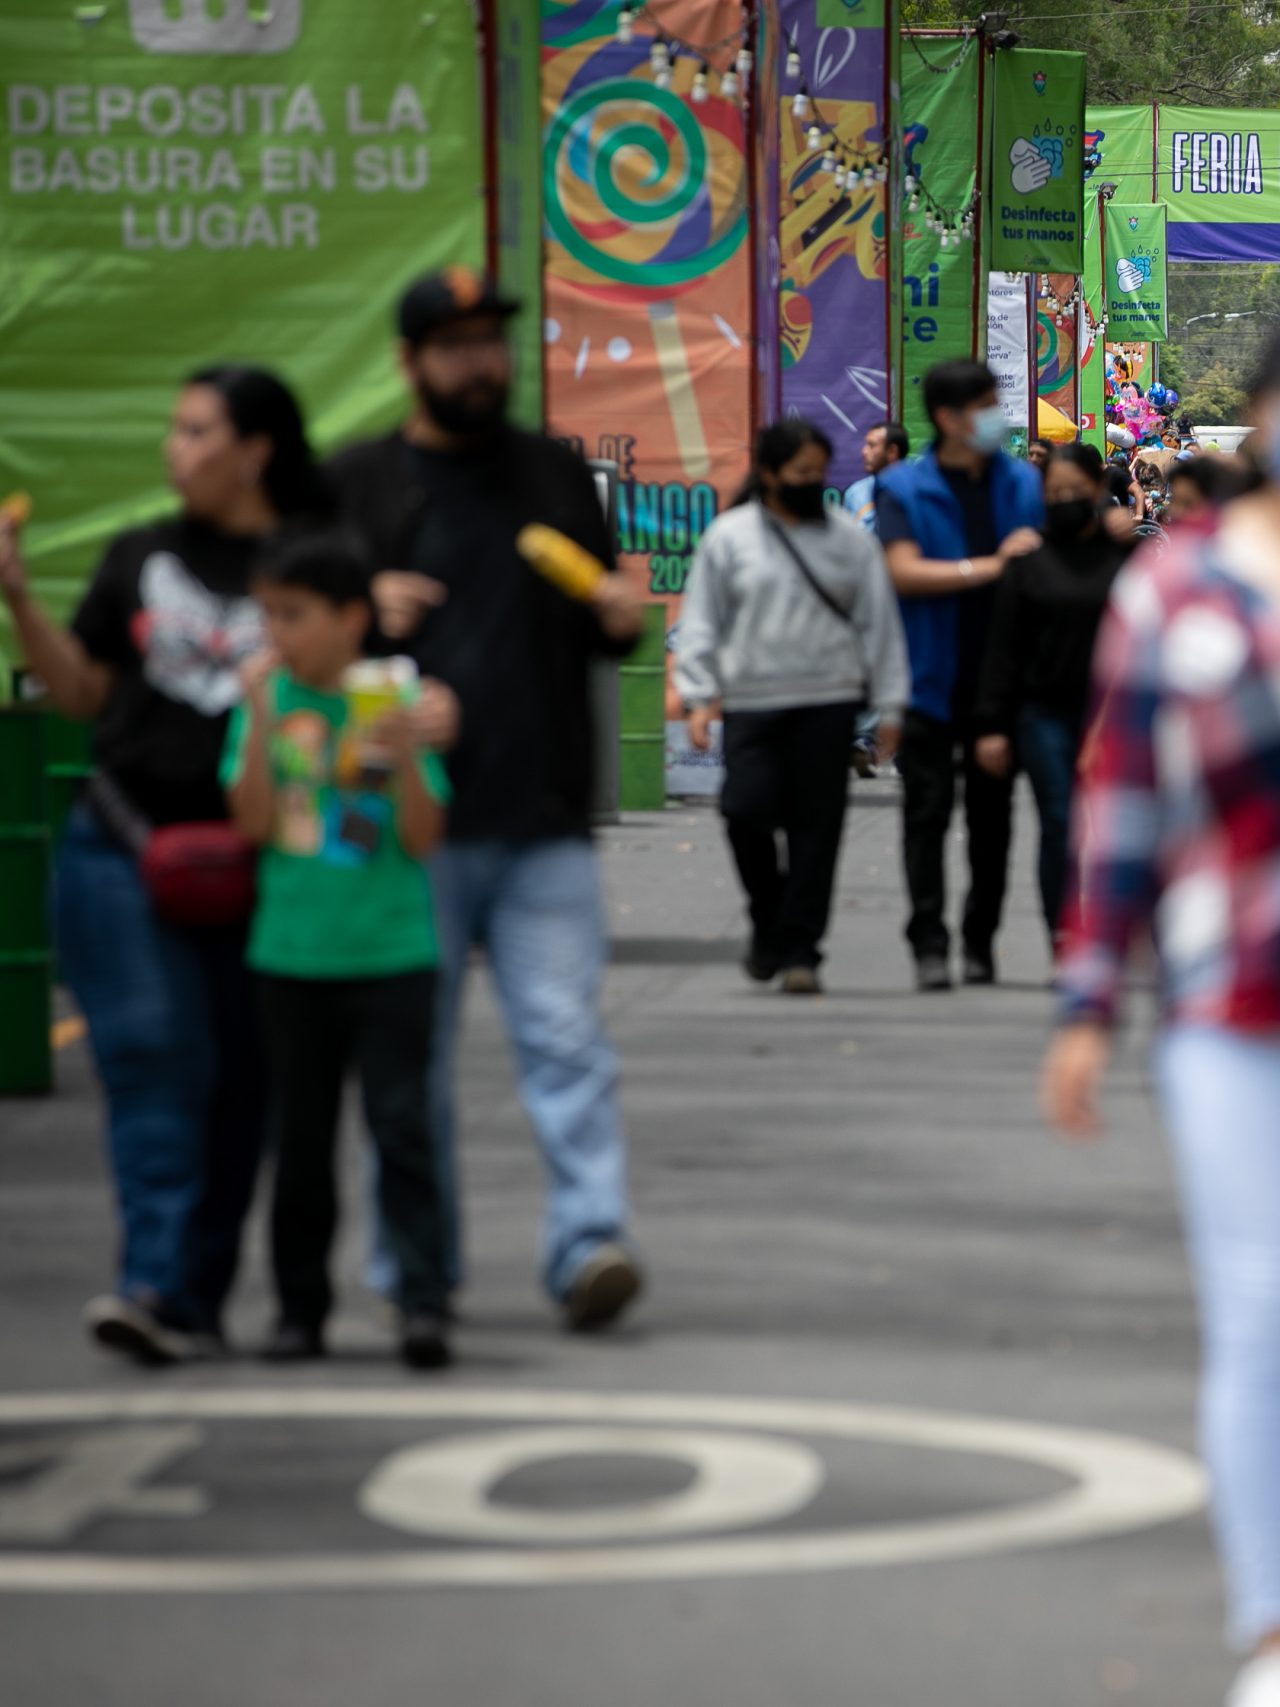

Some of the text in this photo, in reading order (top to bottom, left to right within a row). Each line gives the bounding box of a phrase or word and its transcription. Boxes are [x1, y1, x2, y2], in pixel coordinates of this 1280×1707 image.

[8, 84, 429, 136] DEPOSITA LA
[10, 146, 429, 193] BASURA EN SU
[1172, 132, 1263, 194] FERIA
[1001, 205, 1076, 223] Desinfecta
[122, 204, 319, 249] LUGAR
[1002, 225, 1074, 242] tus manos
[1111, 301, 1160, 310] Desinfecta
[997, 313, 1009, 321] de
[1113, 313, 1127, 322] tus
